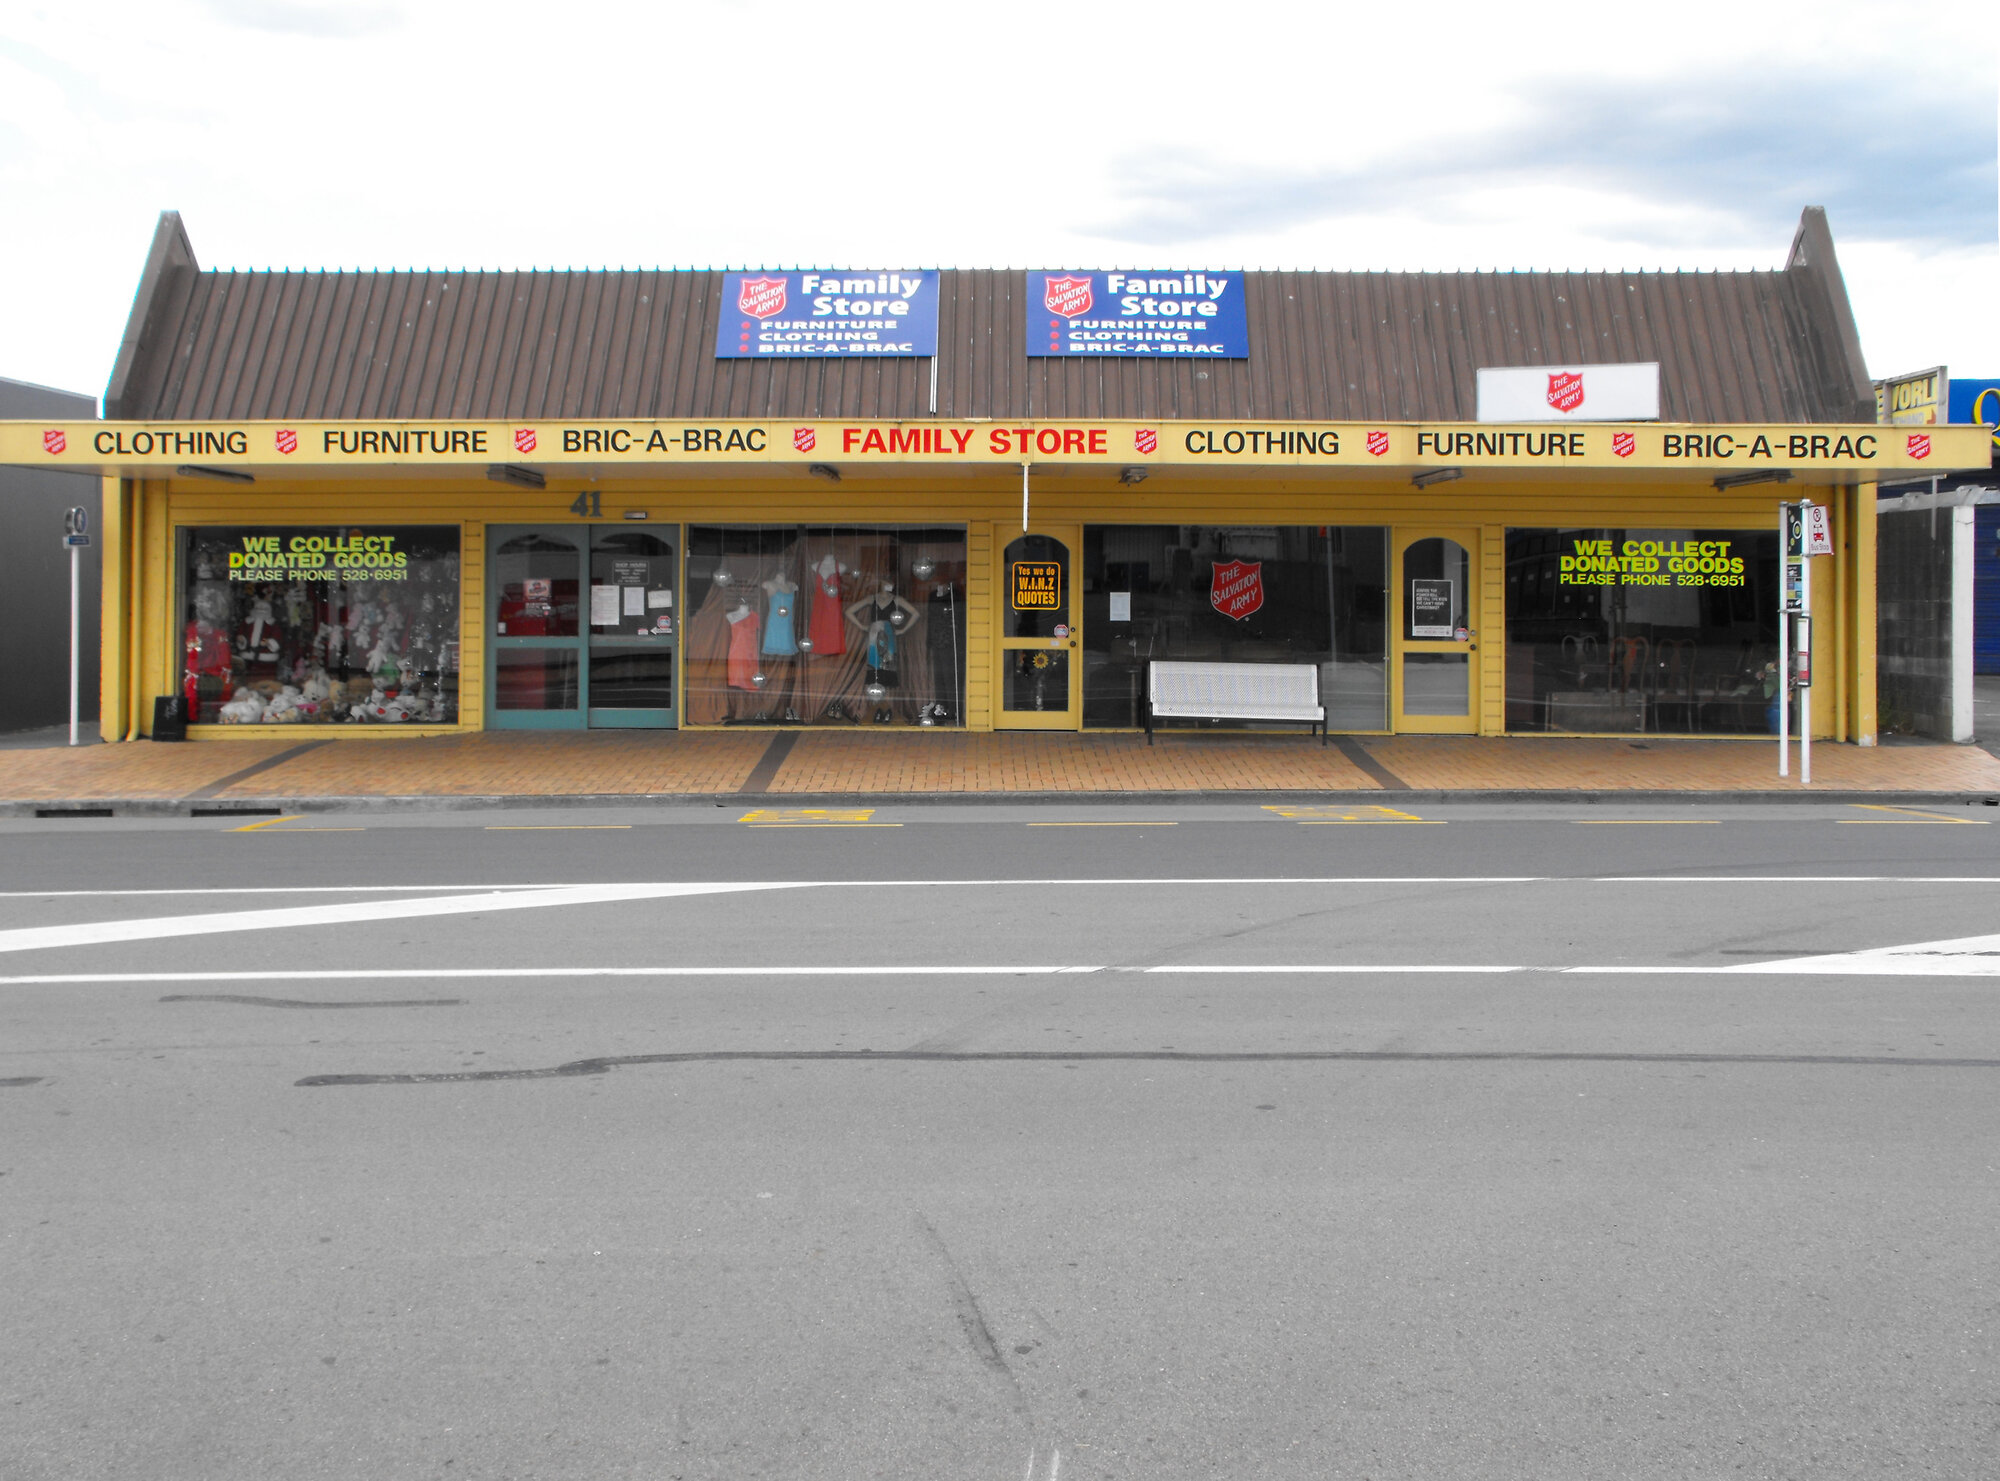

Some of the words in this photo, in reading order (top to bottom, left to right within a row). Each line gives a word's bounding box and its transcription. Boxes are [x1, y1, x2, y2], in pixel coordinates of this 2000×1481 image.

[750, 282, 768, 295] THE
[802, 274, 922, 298] Family
[1048, 282, 1088, 308] SALVATION
[1054, 281, 1072, 294] THE
[1108, 274, 1228, 299] Family
[742, 283, 784, 309] SALVATION
[755, 295, 781, 314] ARMY
[1062, 294, 1087, 313] ARMY
[812, 296, 910, 316] Store
[1120, 296, 1218, 317] Store
[760, 320, 898, 330] FURNITURE
[1069, 320, 1207, 330] FURNITURE
[758, 332, 879, 341] CLOTHING
[1068, 332, 1189, 341] CLOTHING
[758, 343, 913, 353] BRIC-A-BRAC
[1069, 343, 1225, 353] BRIC-A-BRAC
[1548, 379, 1581, 404] SALVATION
[1553, 376, 1568, 389] THE
[1560, 390, 1581, 409] ARMY
[94, 431, 248, 455] CLOTHING
[324, 430, 488, 454] FURNITURE
[562, 428, 767, 453] BRIC-A-BRAC
[842, 428, 975, 454] FAMILY
[989, 428, 1108, 454] STORE
[1185, 430, 1340, 455] CLOTHING
[1417, 432, 1585, 457] FURNITURE
[1663, 433, 1878, 460] BRIC-A-BRAC
[570, 490, 603, 518] 41
[242, 537, 280, 553] WE
[289, 536, 395, 553] COLLECT
[1574, 540, 1613, 556] WE
[1622, 540, 1731, 557] COLLECT
[229, 552, 326, 568] DONATED
[333, 552, 408, 568] GOODS
[1560, 556, 1660, 573] DONATED
[1667, 557, 1745, 574] GOODS
[229, 570, 283, 581] PLEASE
[288, 570, 337, 581] PHONE
[1018, 566, 1030, 576] Yes
[1046, 566, 1055, 576] do
[1220, 566, 1240, 584] THE
[1560, 573, 1616, 585] PLEASE
[1621, 574, 1671, 586] PHONE
[1019, 577, 1054, 590] W.I.N.Z
[1213, 570, 1258, 605] SALVATION
[1017, 591, 1055, 606] QUOTES
[1229, 587, 1258, 613] ARMY
